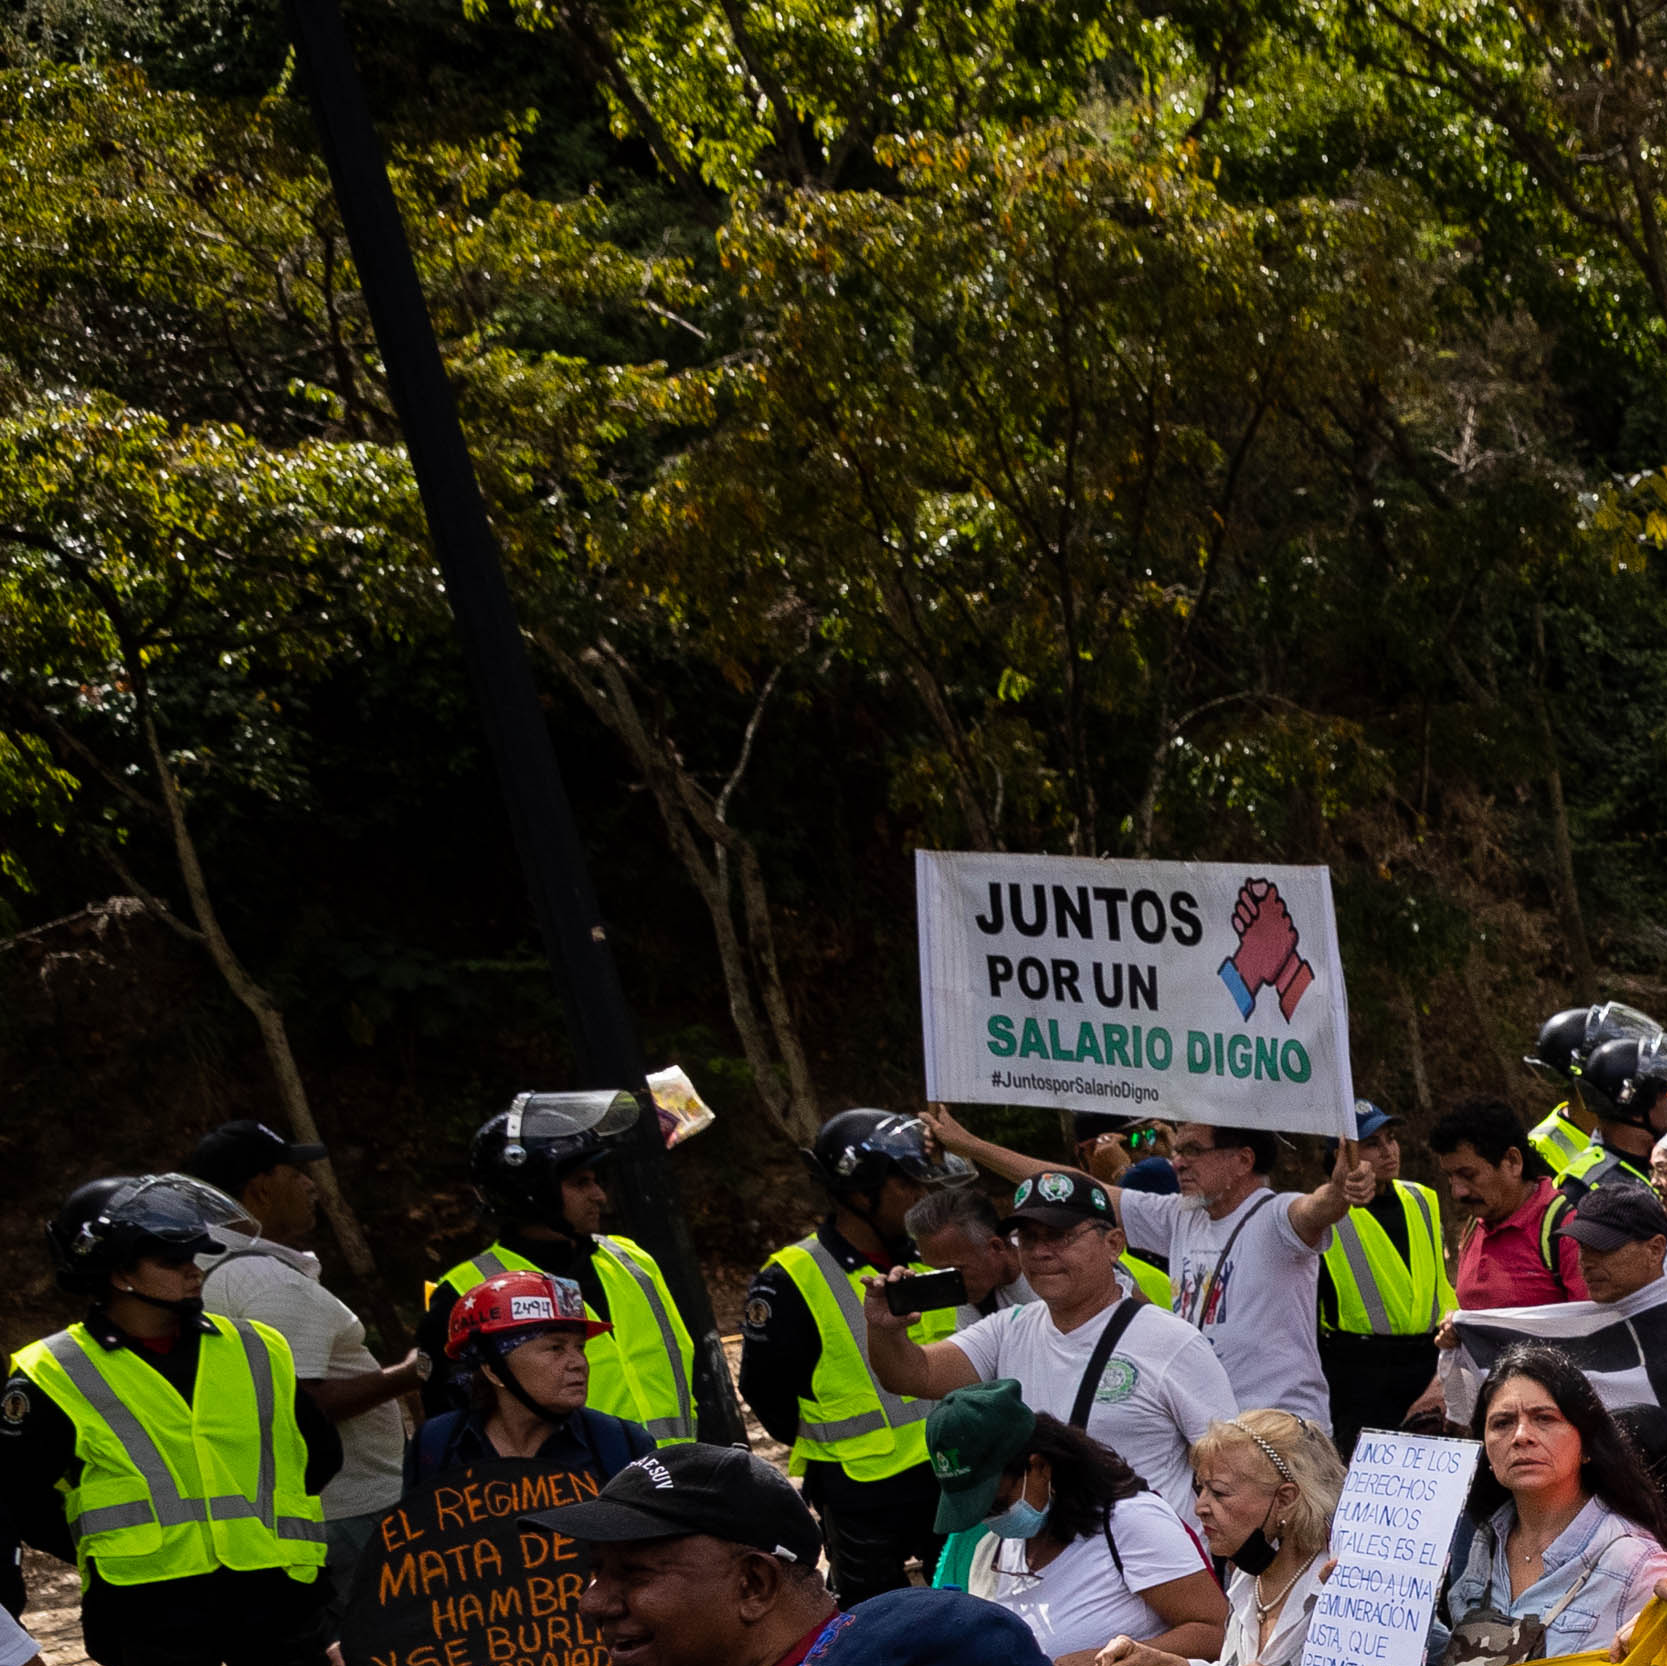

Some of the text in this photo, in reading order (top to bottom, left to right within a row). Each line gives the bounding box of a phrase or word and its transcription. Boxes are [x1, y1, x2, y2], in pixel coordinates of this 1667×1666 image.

[975, 882, 1202, 946] JUNTOS
[986, 954, 1159, 1011] POR UN
[987, 1015, 1312, 1083] SALARIO DIGNO
[991, 1071, 1159, 1102] #JuntosporSalarioDigno
[513, 1300, 551, 1318] 2494
[1355, 1443, 1462, 1474] UNOS DE LOS
[1345, 1471, 1438, 1501] DERECHOS
[380, 1468, 600, 1552] EL RÉGIMEN
[1338, 1501, 1422, 1531] HUMANOS
[1393, 1538, 1416, 1561] ES
[1419, 1542, 1439, 1566] EL
[379, 1532, 578, 1606] MATA DE
[1384, 1574, 1396, 1597] A
[1399, 1576, 1433, 1602] UNA
[432, 1572, 596, 1640] HAMBR
[486, 1616, 604, 1663] BURL
[1349, 1630, 1389, 1659] QUE
